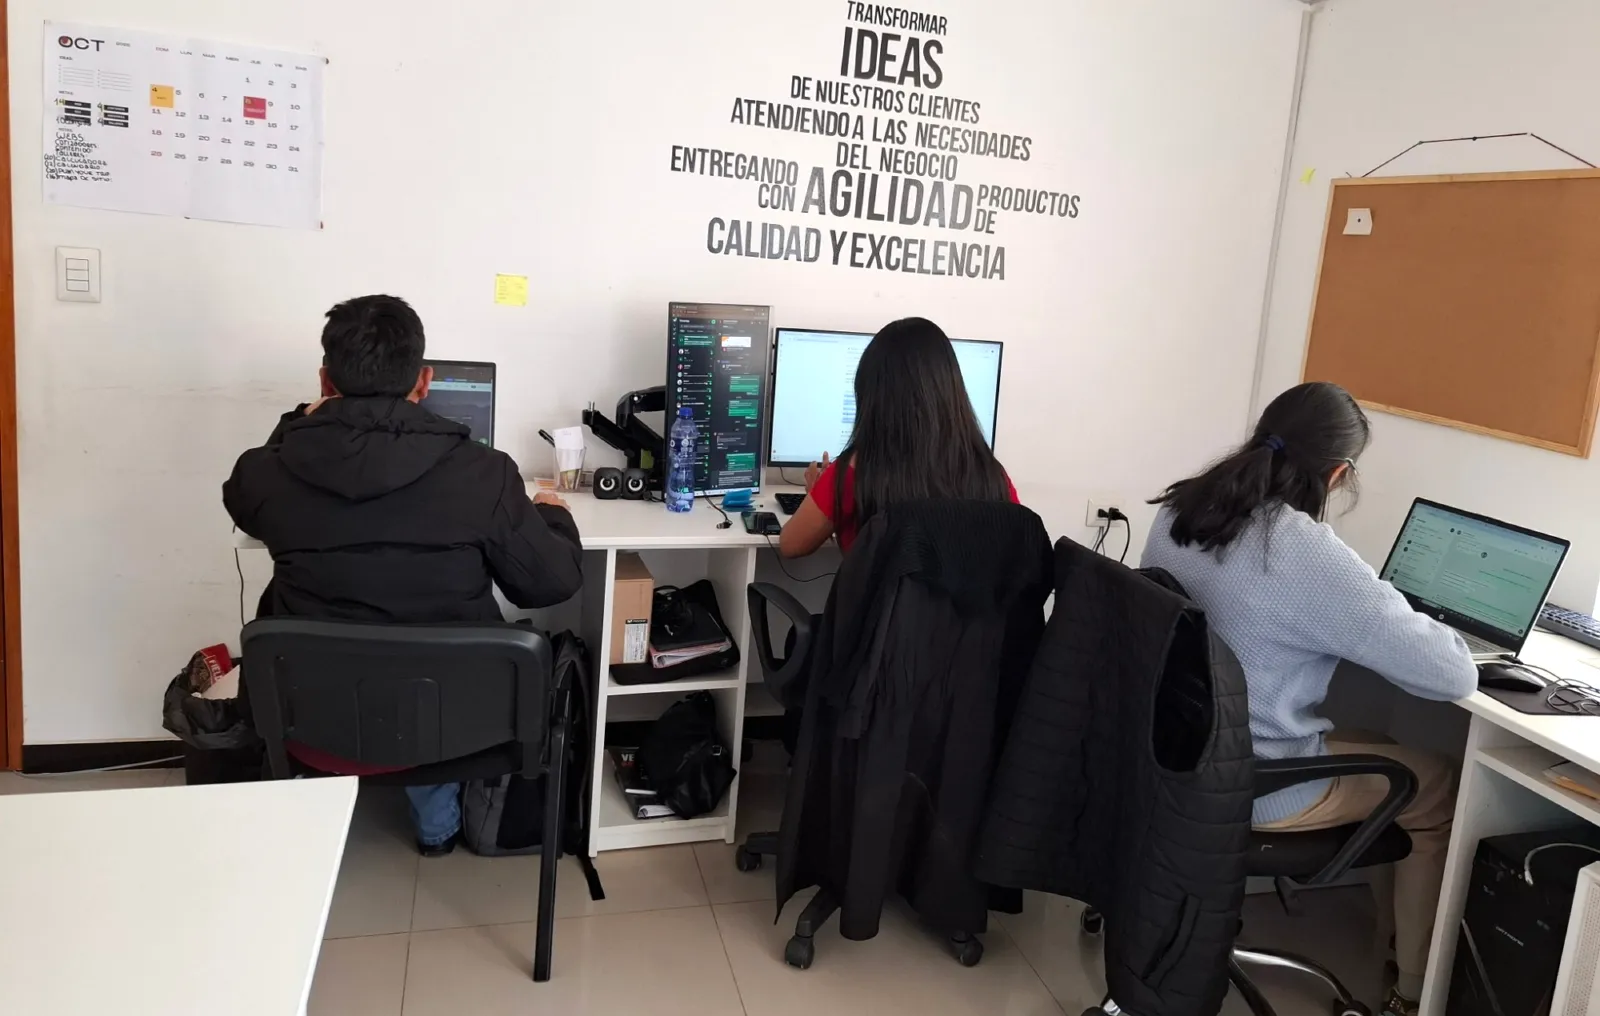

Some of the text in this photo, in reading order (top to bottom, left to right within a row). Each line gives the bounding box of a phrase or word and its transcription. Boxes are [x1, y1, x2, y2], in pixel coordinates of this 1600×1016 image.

[846, 0, 948, 36] TRANSFORMAR
[58, 35, 105, 52] OCT
[840, 27, 944, 89] IDEAS
[790, 75, 981, 125] DE NUESTROS CLIENTES
[730, 97, 1033, 162] ATENDIENDO A LAS NECESIDADES
[670, 145, 799, 187] ENTREGANDO
[836, 142, 958, 182] DEL NEGOCIO
[757, 166, 1081, 232] CON AGILIDAD PRODUCTOS
[973, 208, 999, 235] DE
[706, 217, 1006, 281] CALIDAD Y EXCELENCIA
